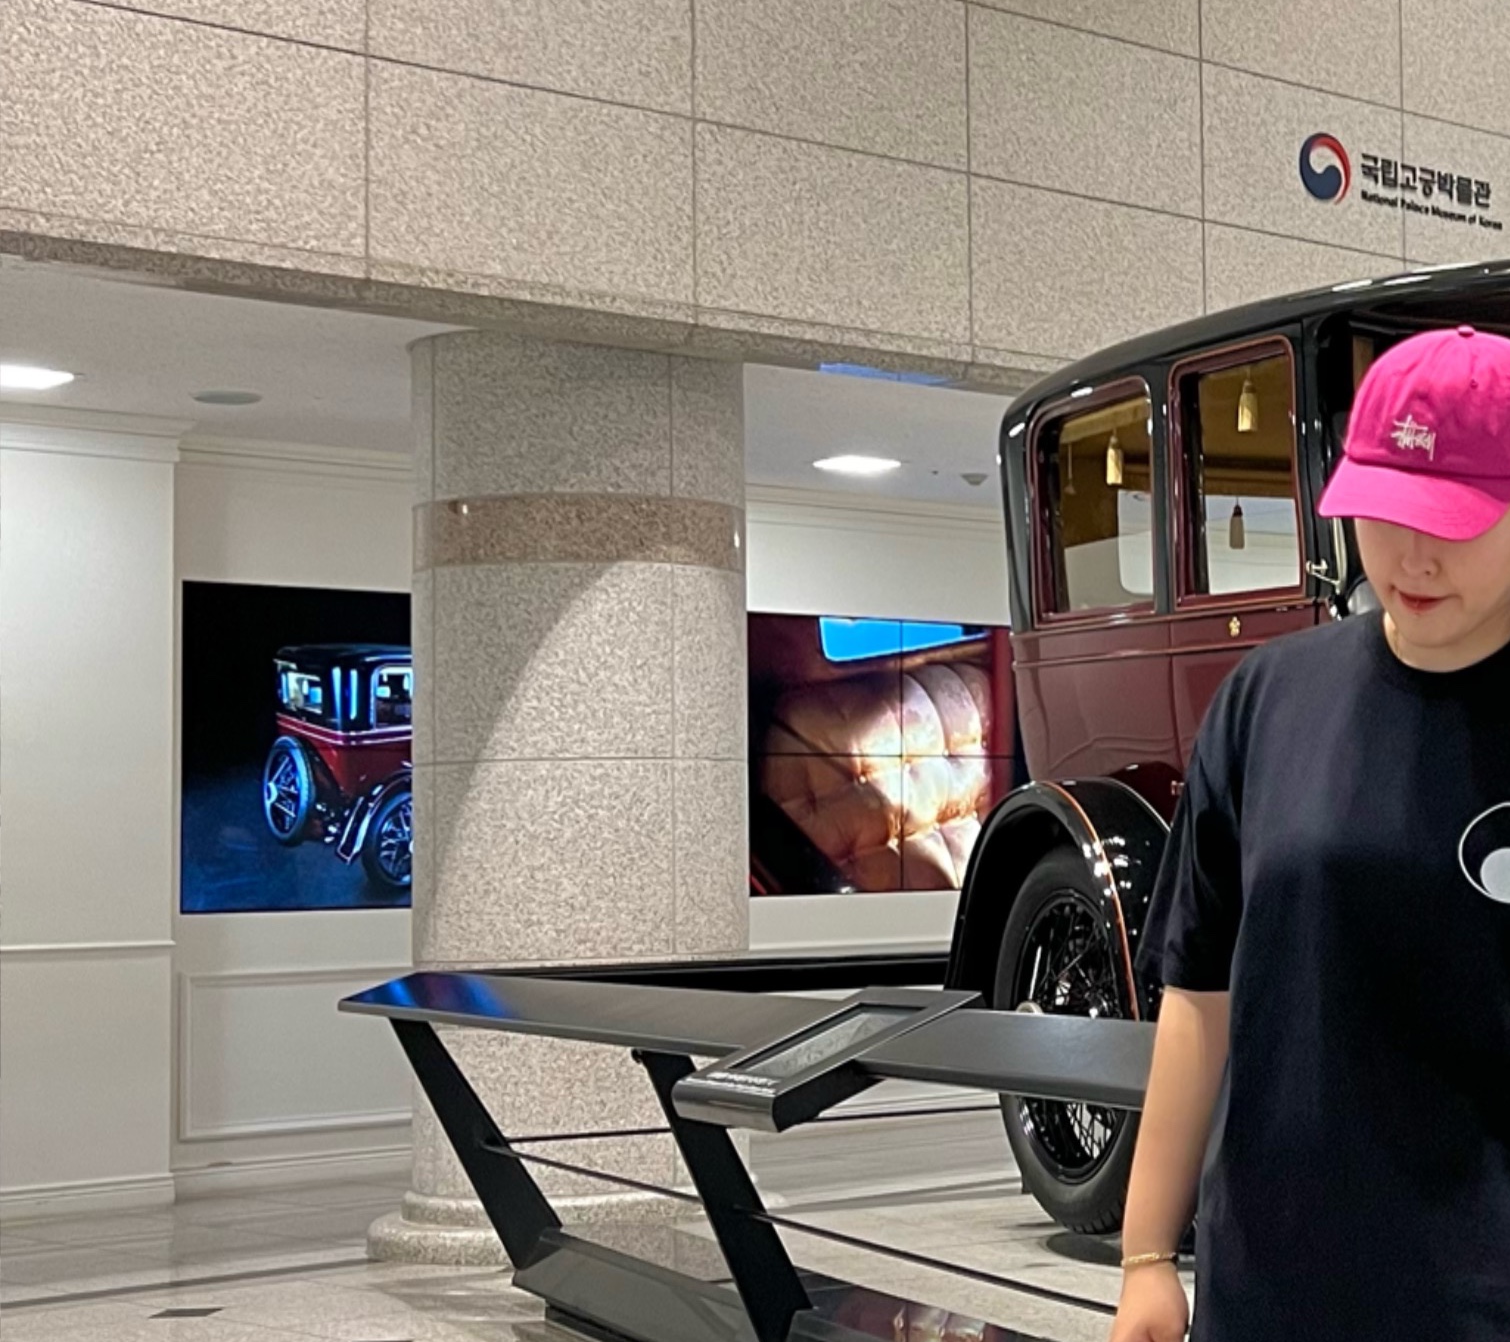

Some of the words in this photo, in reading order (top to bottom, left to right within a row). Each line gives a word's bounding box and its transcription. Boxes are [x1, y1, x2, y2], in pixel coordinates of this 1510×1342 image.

[1360, 152, 1491, 208] 국립고궁박물관
[1360, 189, 1398, 208] National
[1400, 198, 1429, 215] Palace
[1431, 205, 1466, 222] Museum
[1468, 213, 1477, 226] of
[1479, 215, 1503, 231] Korea
